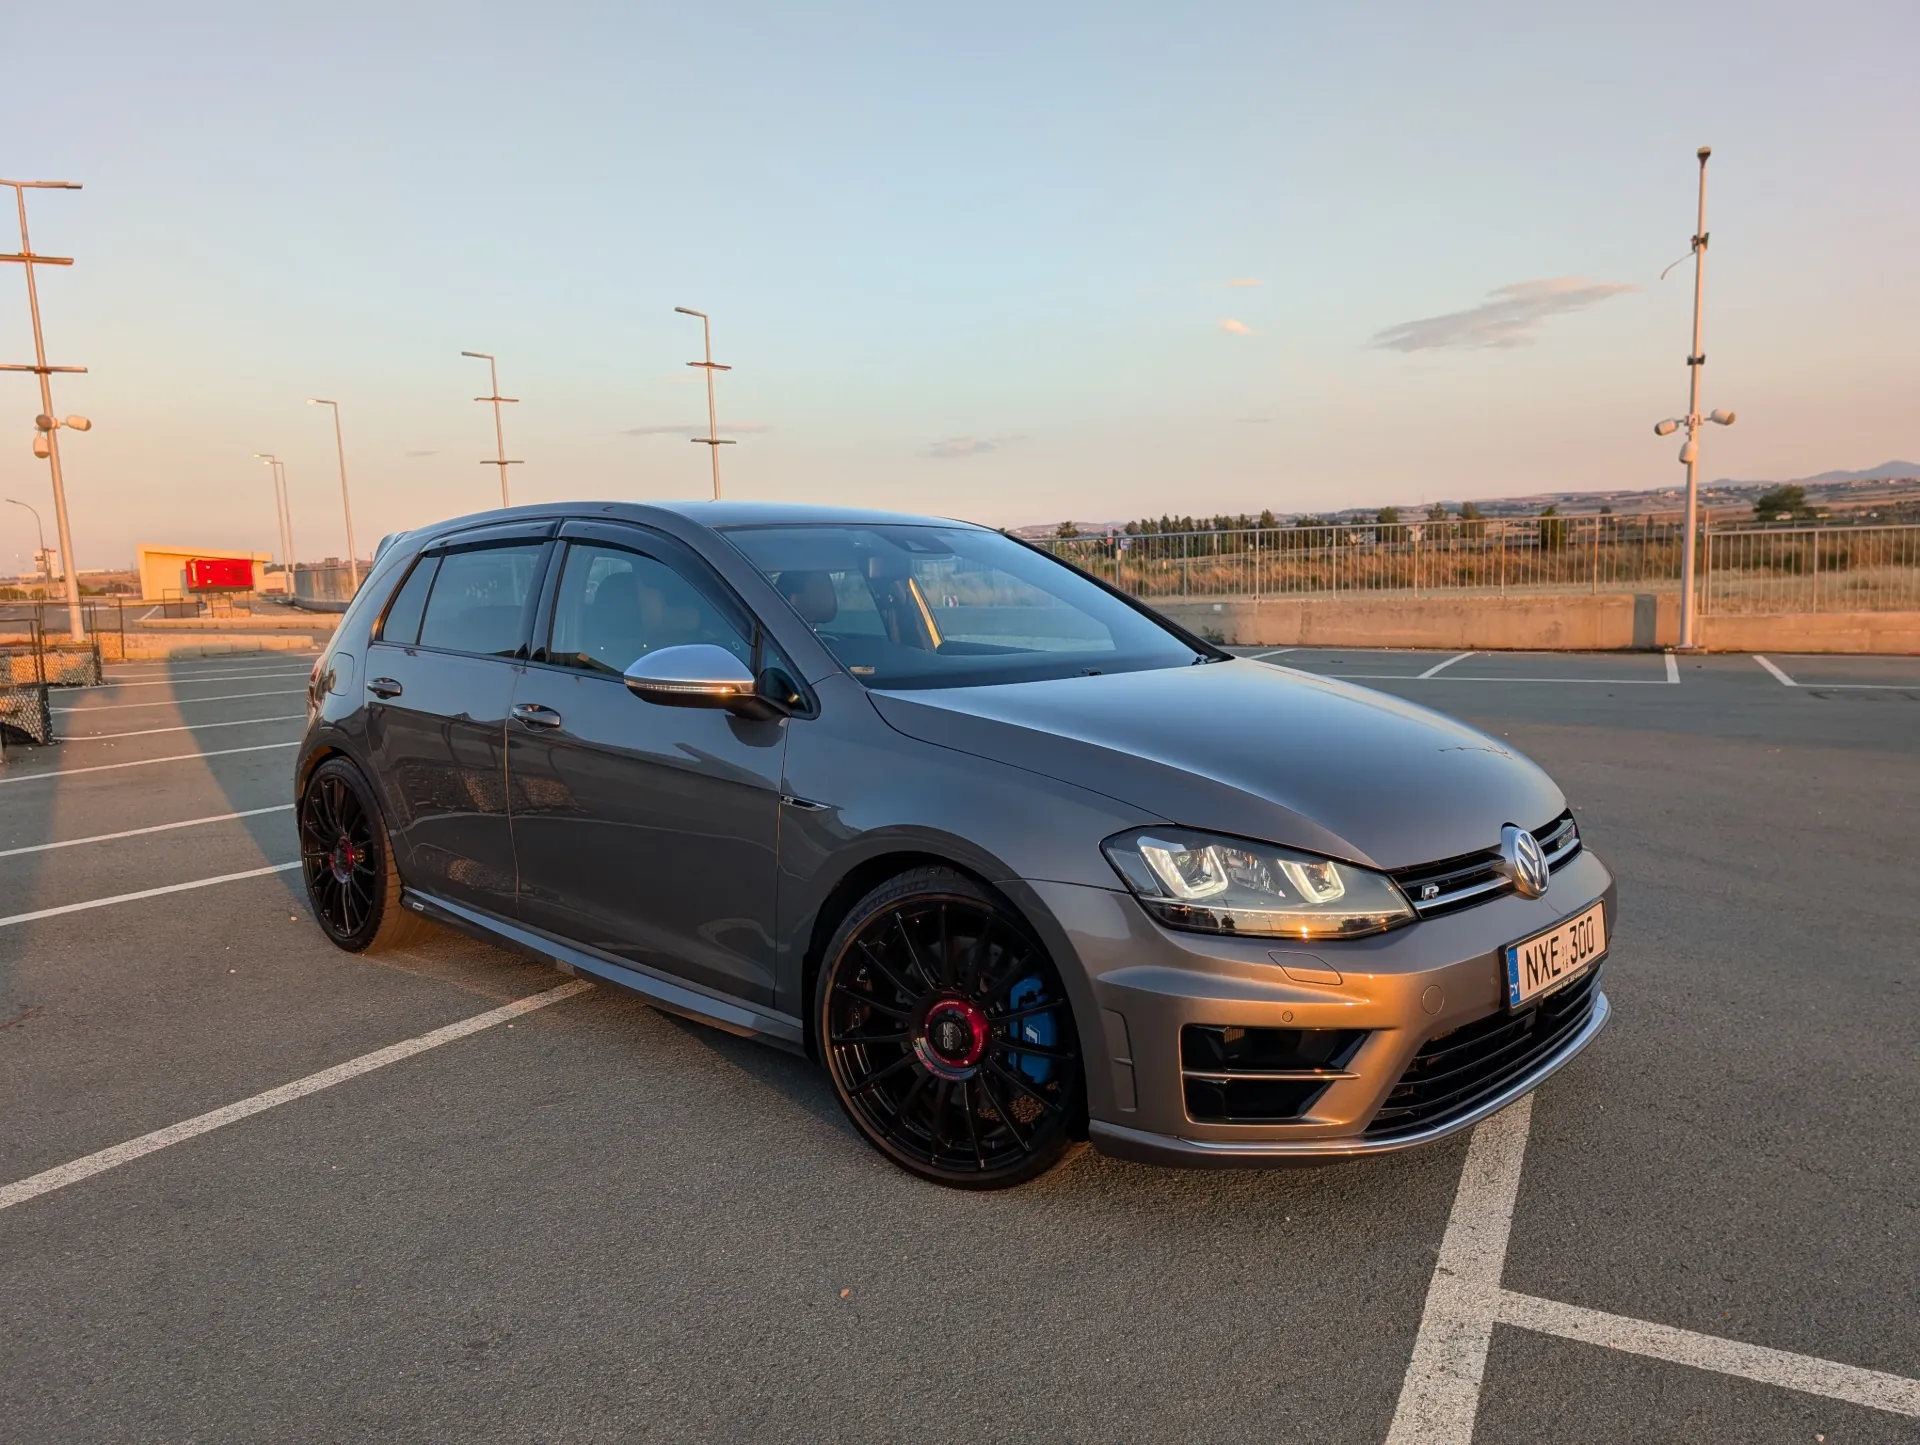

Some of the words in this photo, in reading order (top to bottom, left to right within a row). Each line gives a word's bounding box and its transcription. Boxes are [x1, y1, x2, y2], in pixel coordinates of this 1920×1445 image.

[1421, 883, 1439, 900] R
[1525, 936, 1561, 991] NXE
[1569, 916, 1595, 965] 300
[1510, 982, 1519, 996] CY
